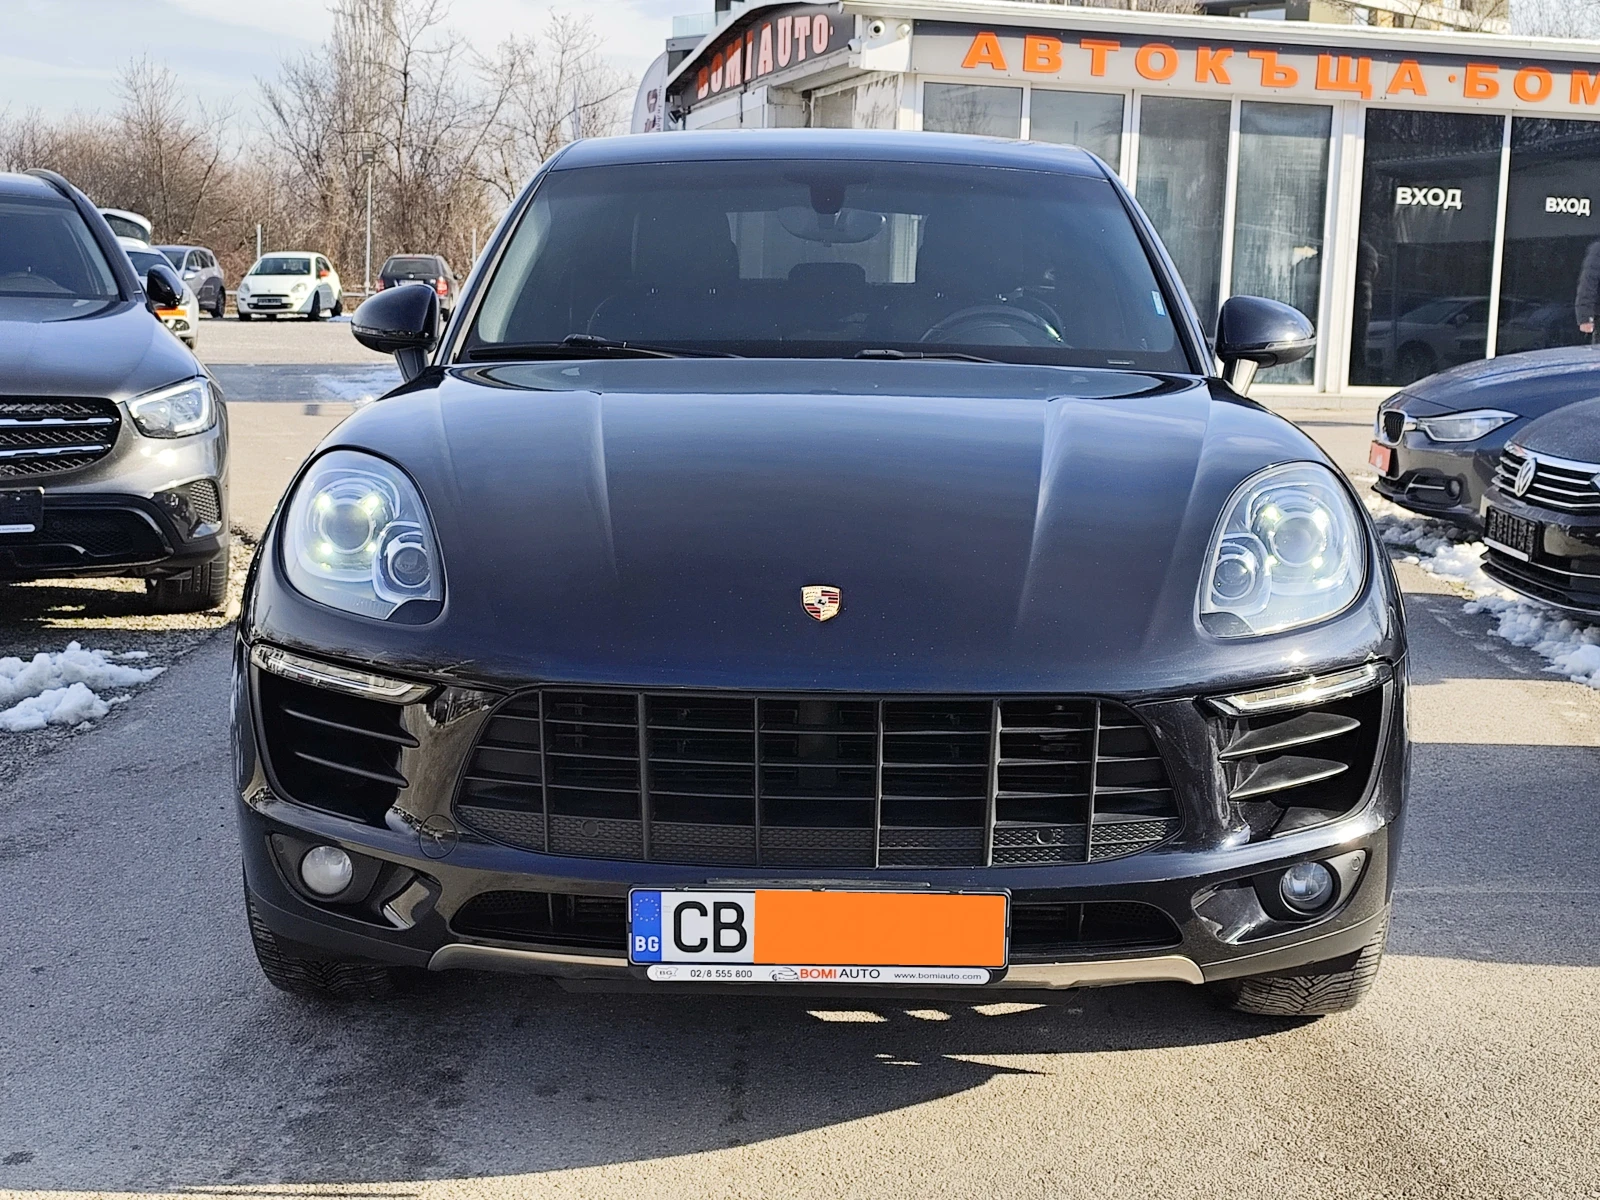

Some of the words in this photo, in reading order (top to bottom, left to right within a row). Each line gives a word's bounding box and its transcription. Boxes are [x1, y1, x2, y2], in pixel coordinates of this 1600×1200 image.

[961, 31, 1428, 99] АВТОКЪЩА
[1396, 187, 1462, 210] ВХОД
[1545, 197, 1591, 216] ВХОД
[673, 901, 748, 953] CB
[635, 936, 659, 952] BG
[690, 969, 712, 979] 02/8
[715, 969, 733, 978] 555
[735, 969, 753, 979] 800
[800, 968, 837, 979] BOMI
[839, 968, 881, 979] AUTO
[894, 972, 982, 980] www.bomiauto.com
